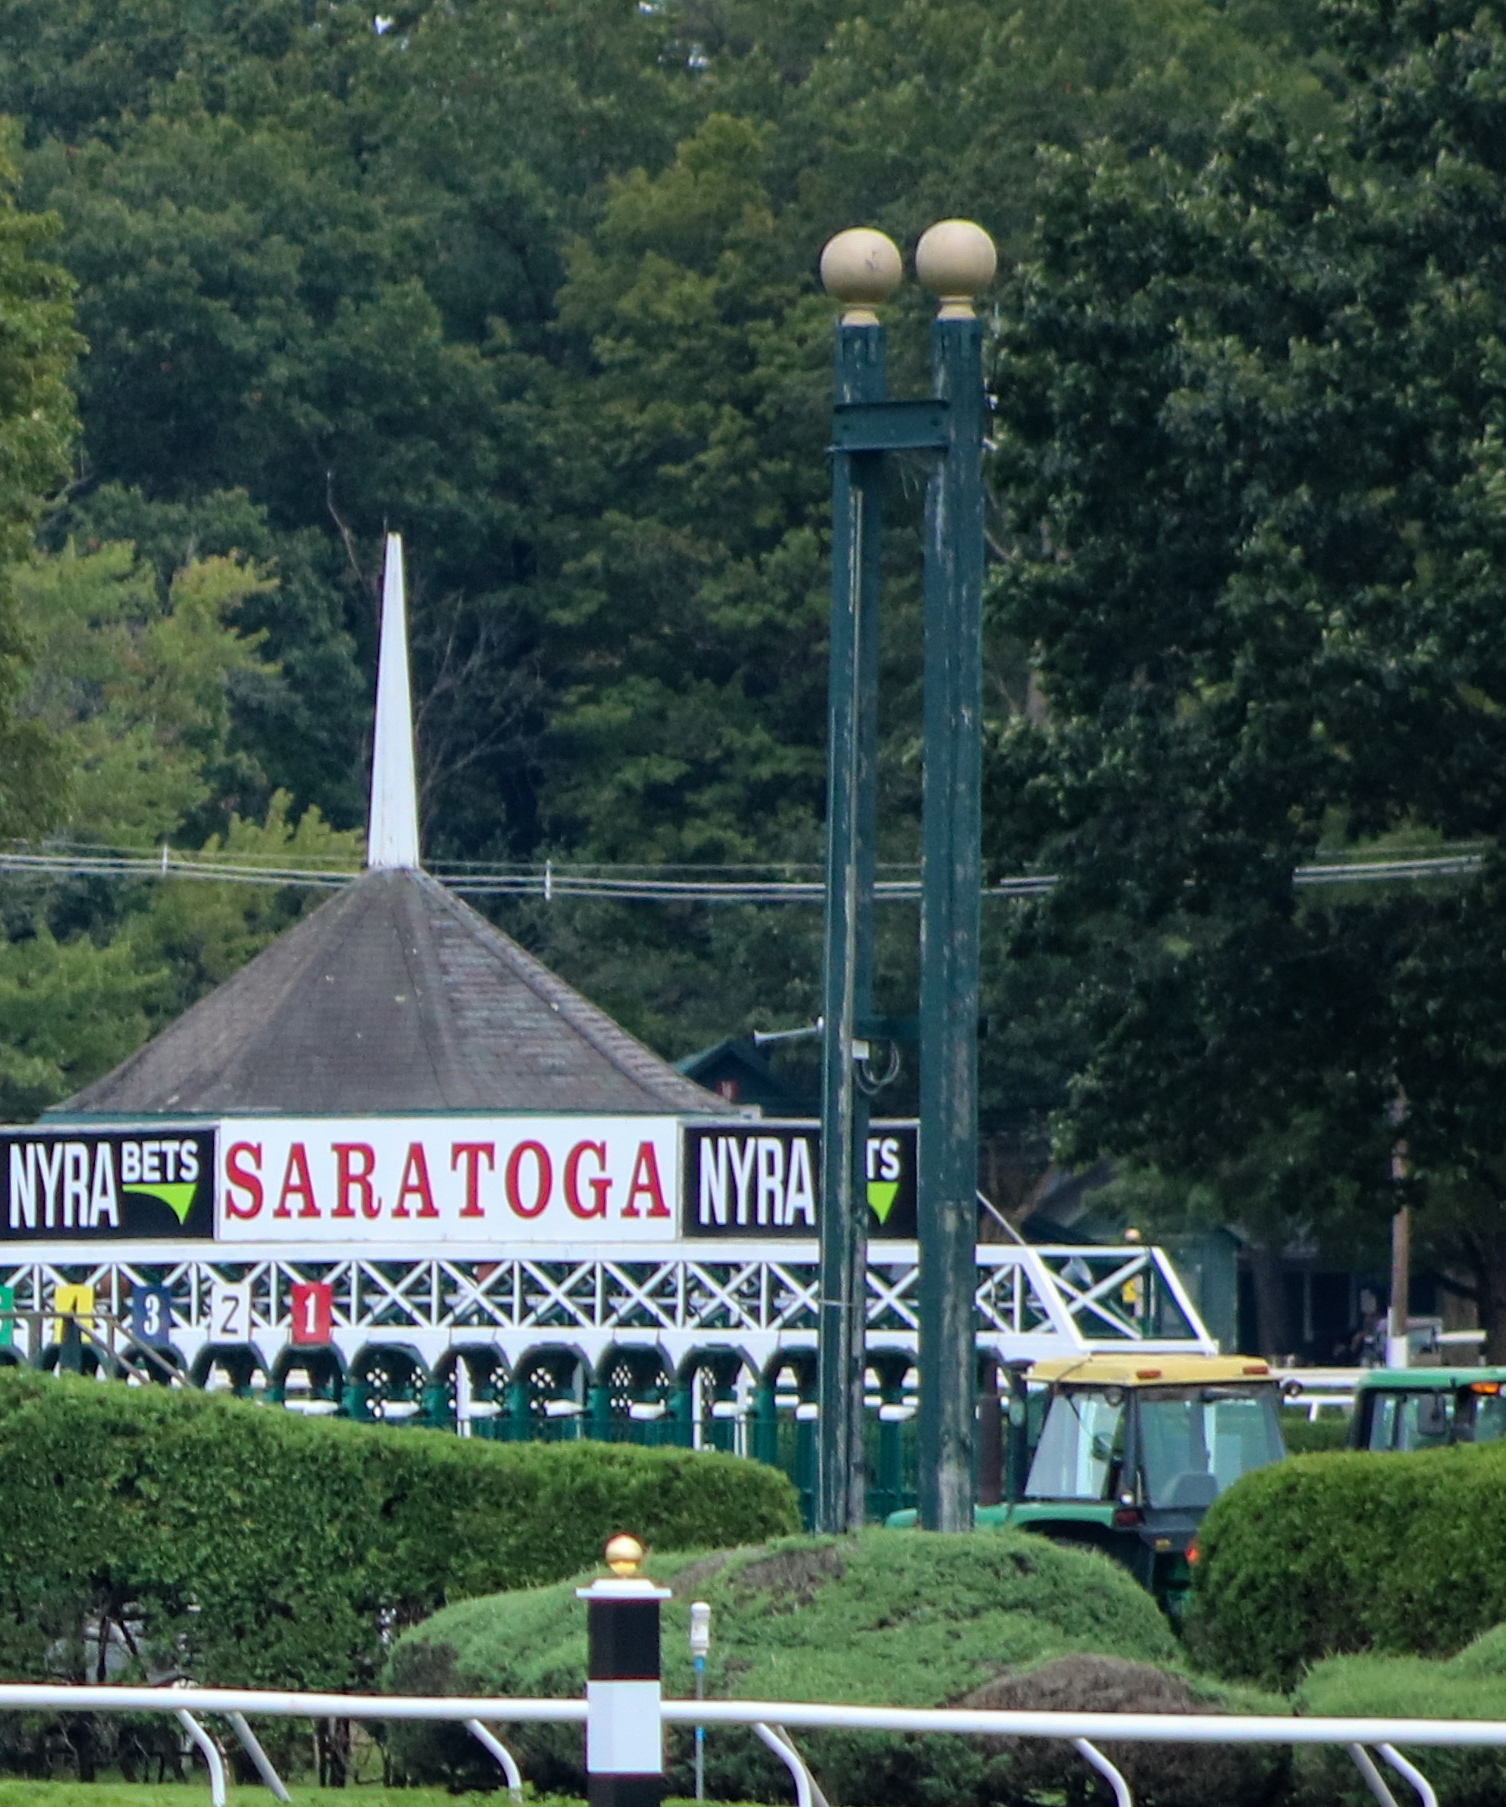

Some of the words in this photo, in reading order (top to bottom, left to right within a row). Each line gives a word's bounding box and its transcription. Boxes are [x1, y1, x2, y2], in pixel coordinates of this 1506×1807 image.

[8, 1140, 120, 1229] NYRA
[121, 1138, 199, 1183] BETS
[224, 1139, 672, 1220] SARATOGA
[698, 1135, 817, 1226] NYRA
[143, 1293, 161, 1337] 3
[219, 1294, 240, 1335] 2
[303, 1292, 317, 1334] 1
